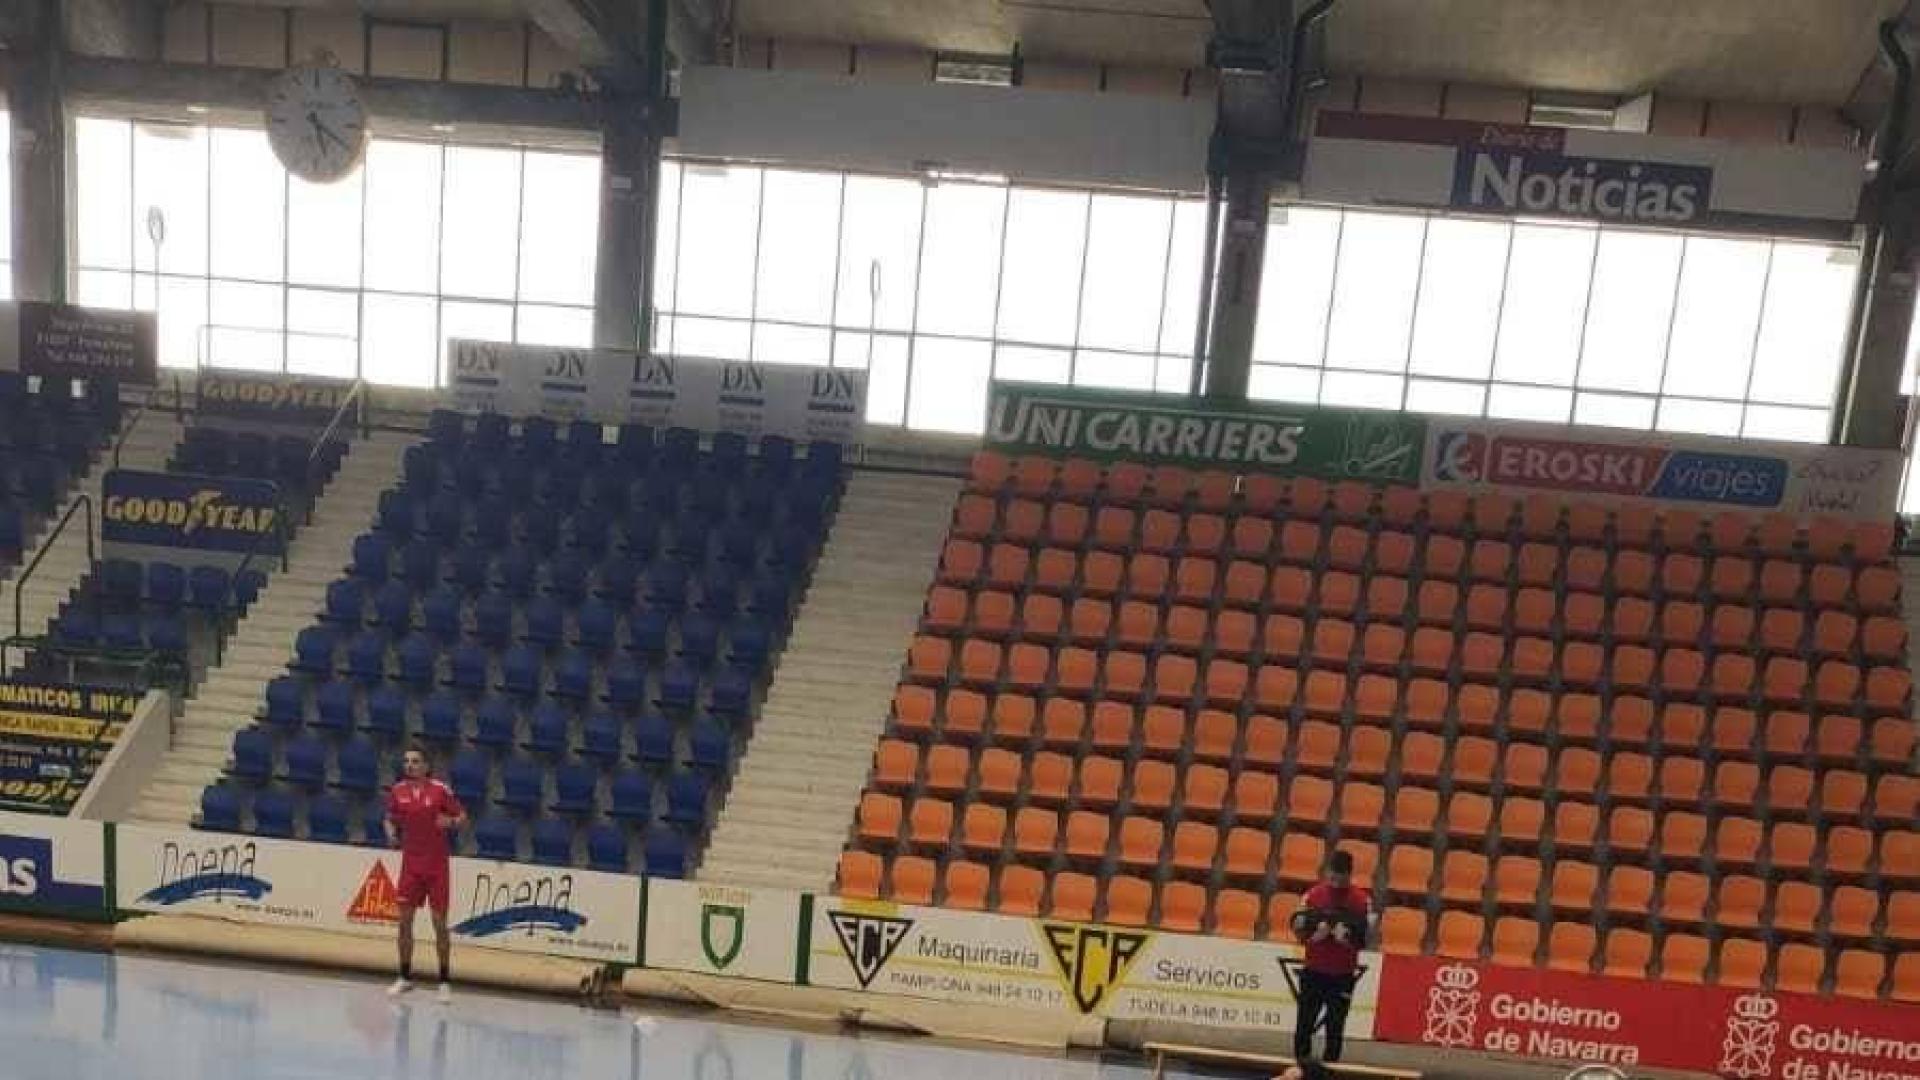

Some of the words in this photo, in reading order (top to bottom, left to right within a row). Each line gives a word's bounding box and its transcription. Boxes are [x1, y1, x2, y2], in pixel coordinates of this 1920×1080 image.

[1470, 153, 1696, 222] Noticias
[457, 342, 498, 372] DN
[722, 364, 765, 393] DN
[811, 372, 854, 400] DN
[1500, 443, 1647, 487] EROSKI
[1670, 458, 1770, 500] viajes
[104, 491, 274, 534] GOODYEAR
[918, 934, 1040, 970] Maquinaria
[1154, 959, 1261, 990] Servicios
[1490, 994, 1620, 1031] Gobierno
[1484, 1027, 1520, 1052] de
[1527, 1030, 1640, 1065] Navarra
[1790, 1024, 1920, 1061] Gobierno
[1782, 1057, 1819, 1080] de
